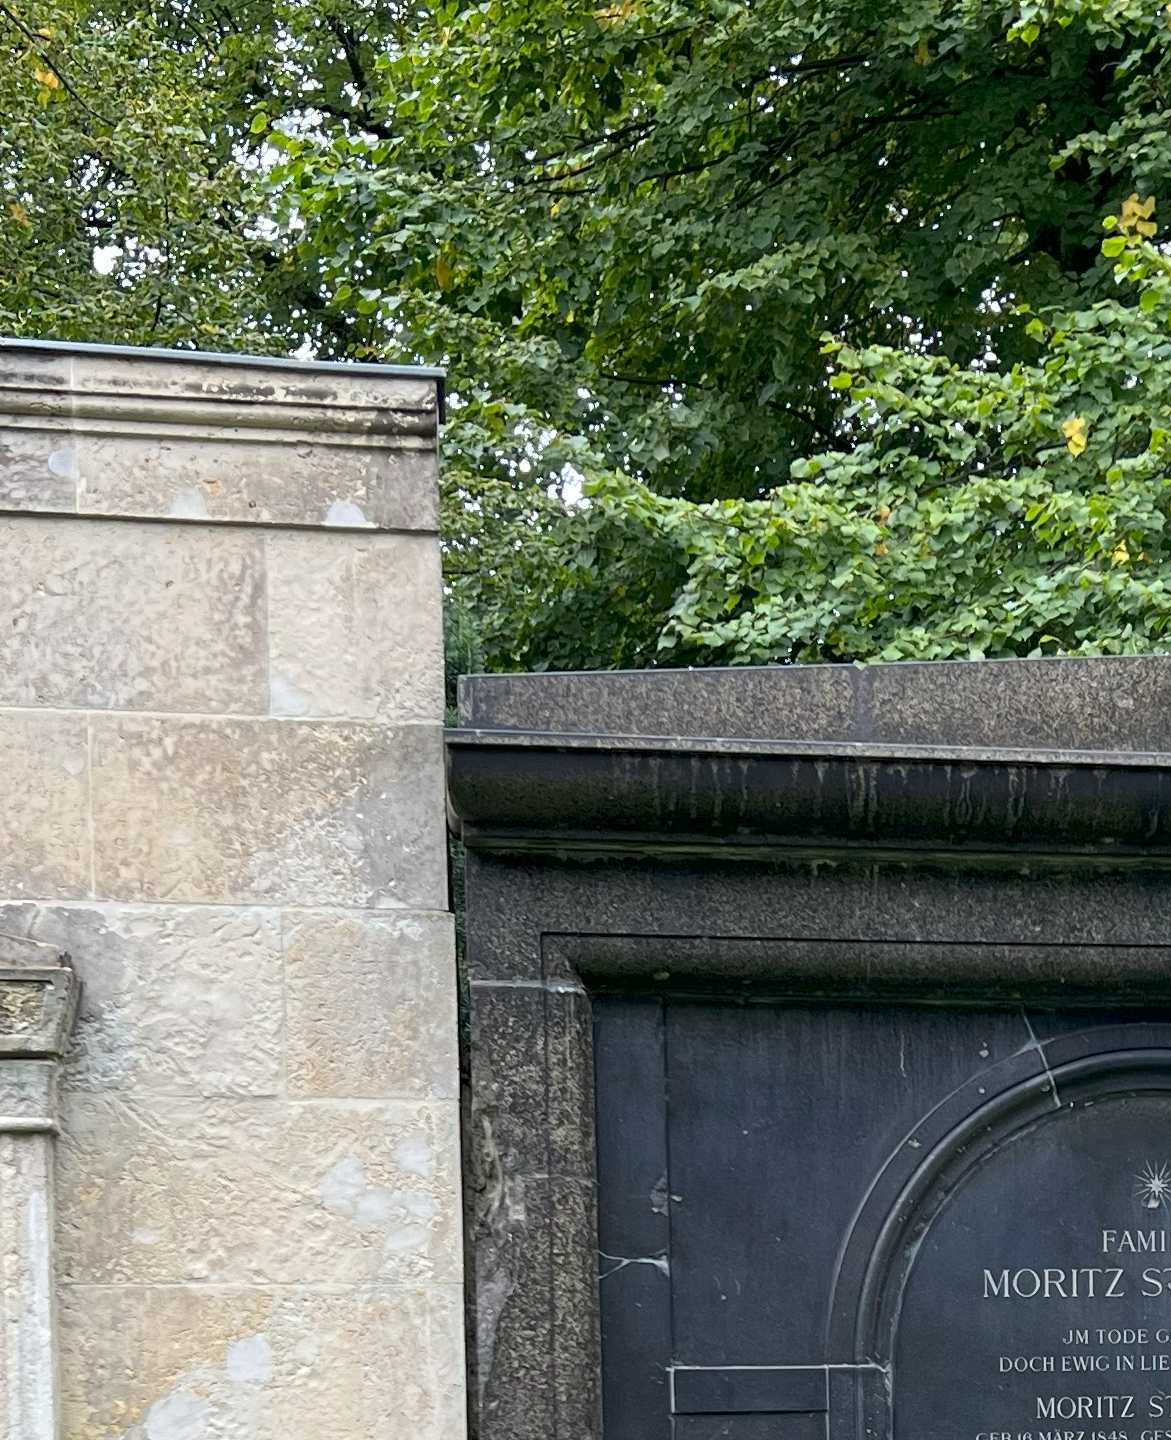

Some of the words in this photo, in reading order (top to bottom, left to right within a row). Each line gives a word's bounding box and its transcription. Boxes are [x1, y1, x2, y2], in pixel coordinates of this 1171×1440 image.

[983, 1268, 1125, 1299] MORITZ
[1096, 1328, 1149, 1344] TODE
[999, 1356, 1055, 1372] DOCH
[1061, 1355, 1110, 1372] EWIG
[1116, 1354, 1135, 1371] IN
[1036, 1396, 1135, 1419] MORITZ
